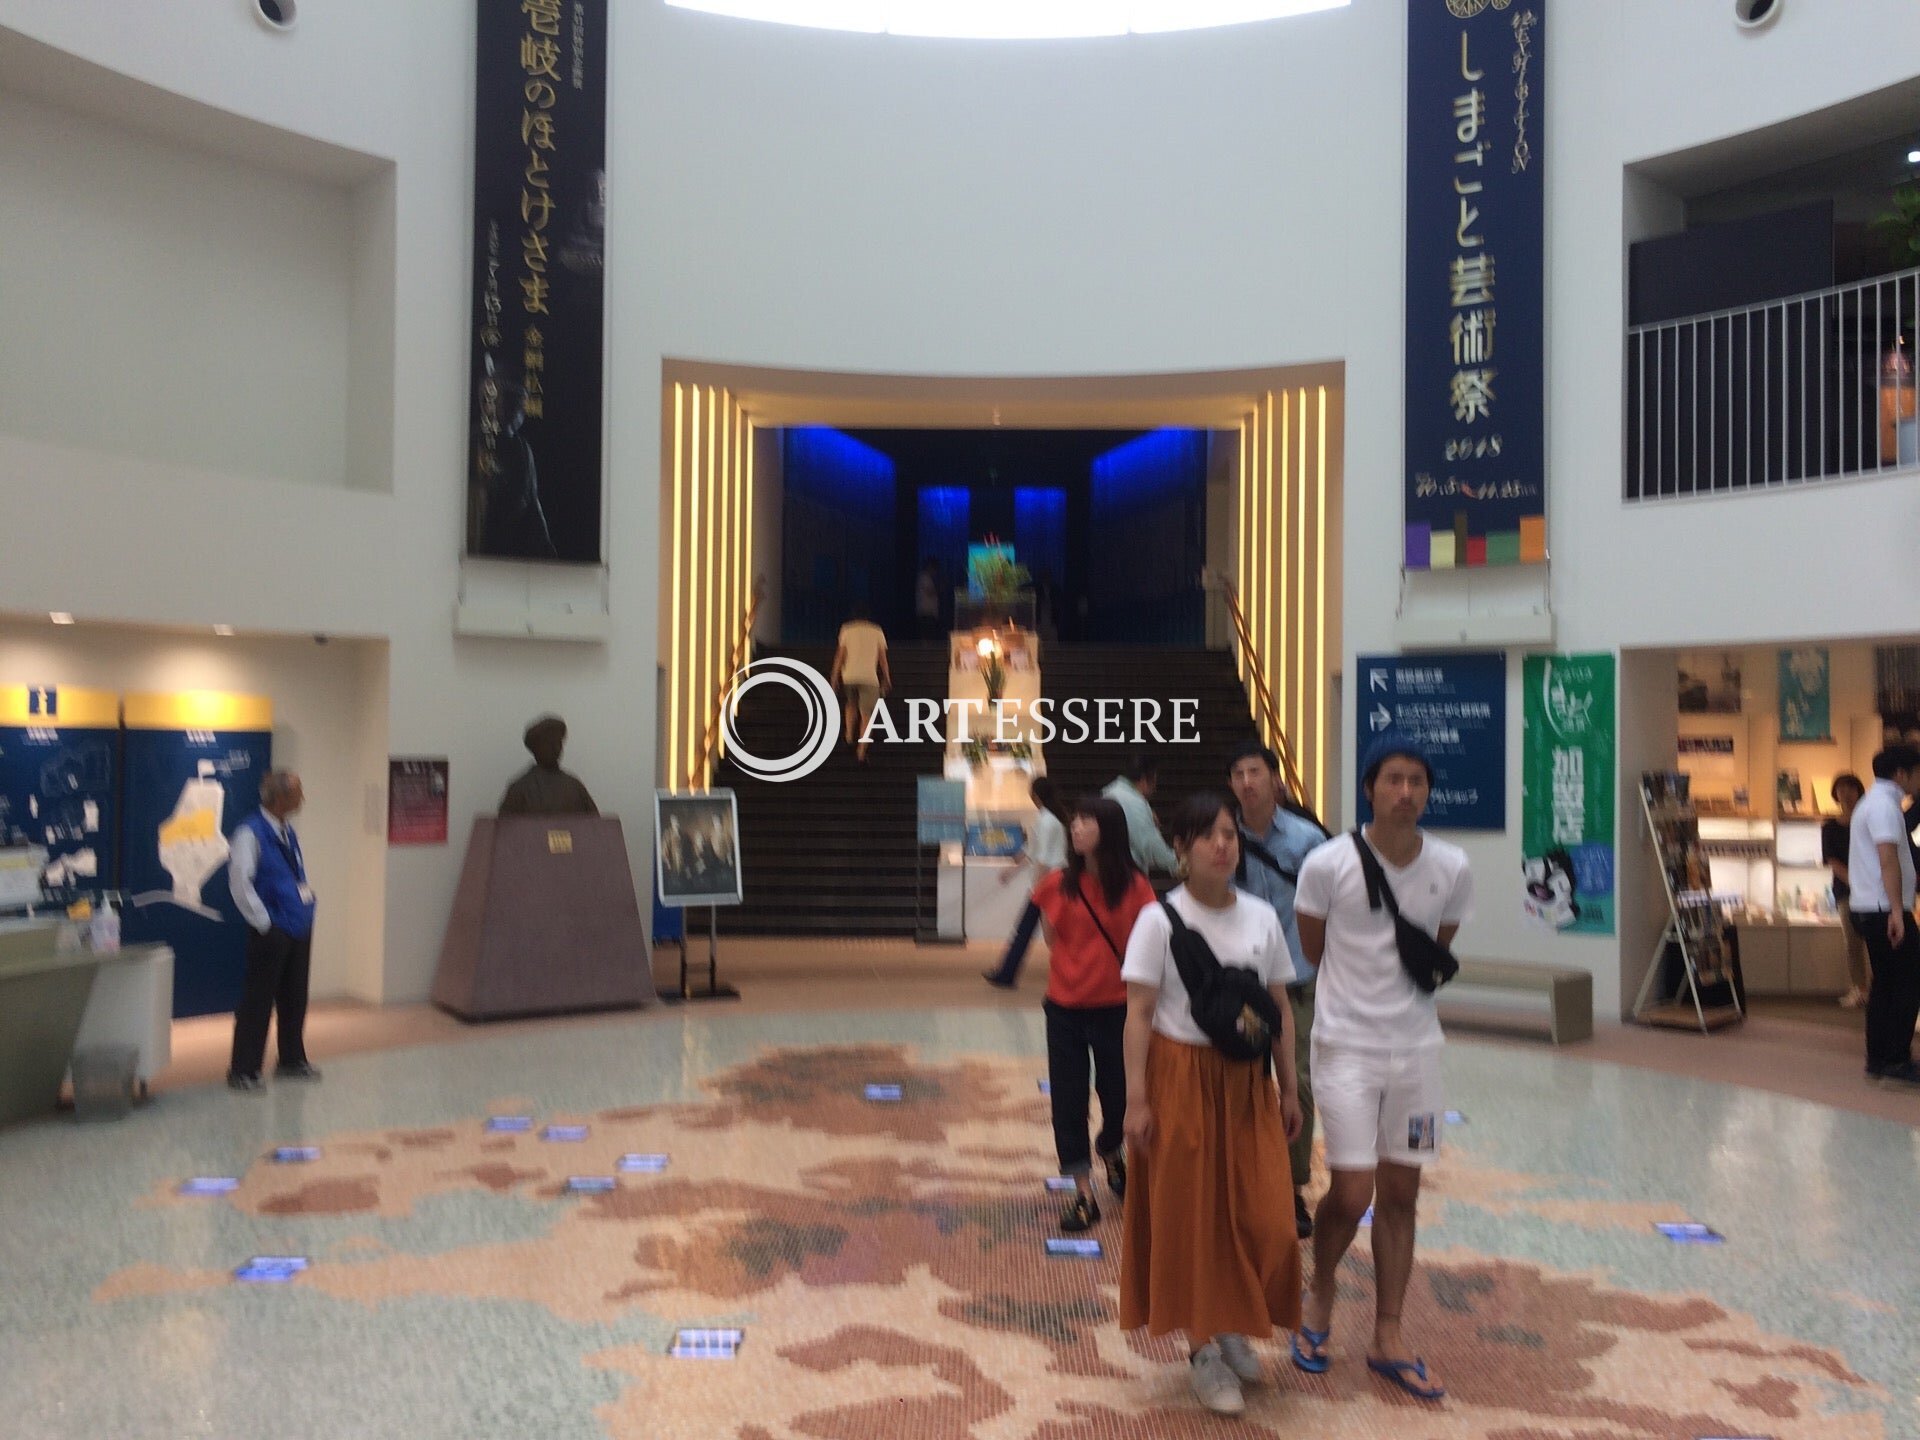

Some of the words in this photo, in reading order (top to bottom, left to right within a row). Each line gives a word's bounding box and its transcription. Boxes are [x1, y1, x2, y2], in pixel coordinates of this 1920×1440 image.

[1449, 29, 1498, 424] しまごと芸術祭
